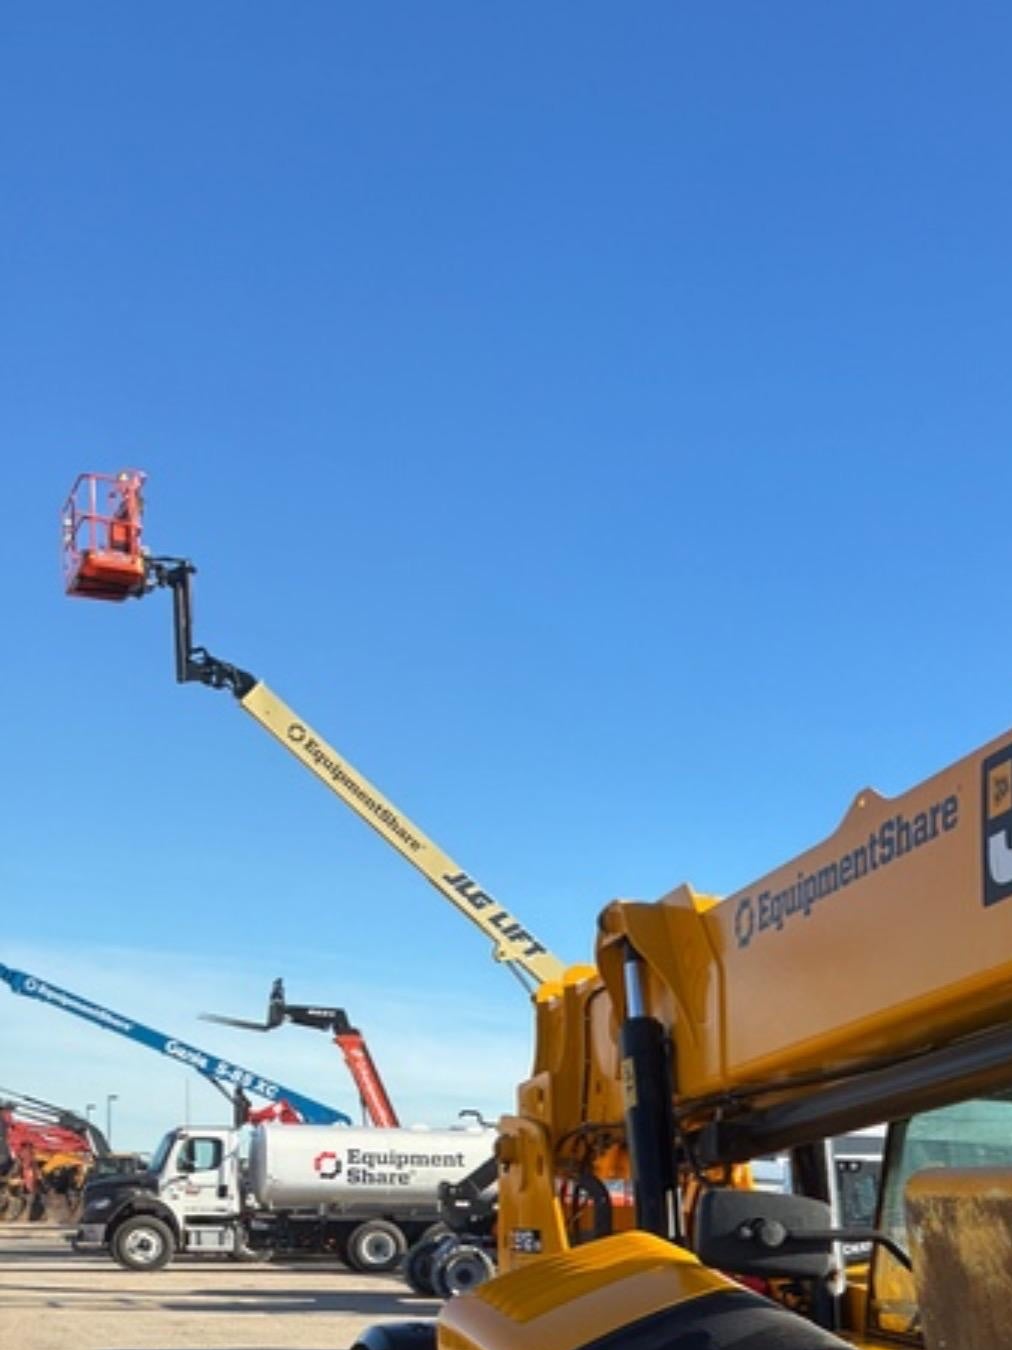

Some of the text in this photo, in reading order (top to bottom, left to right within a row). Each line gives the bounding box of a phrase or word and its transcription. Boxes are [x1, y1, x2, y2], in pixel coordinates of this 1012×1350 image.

[305, 737, 421, 852] EquipmentShare
[756, 795, 960, 932] EquipmentShare
[442, 872, 547, 958] JLG LIFT
[347, 1148, 466, 1168] Equipment
[347, 1167, 412, 1185] Share
